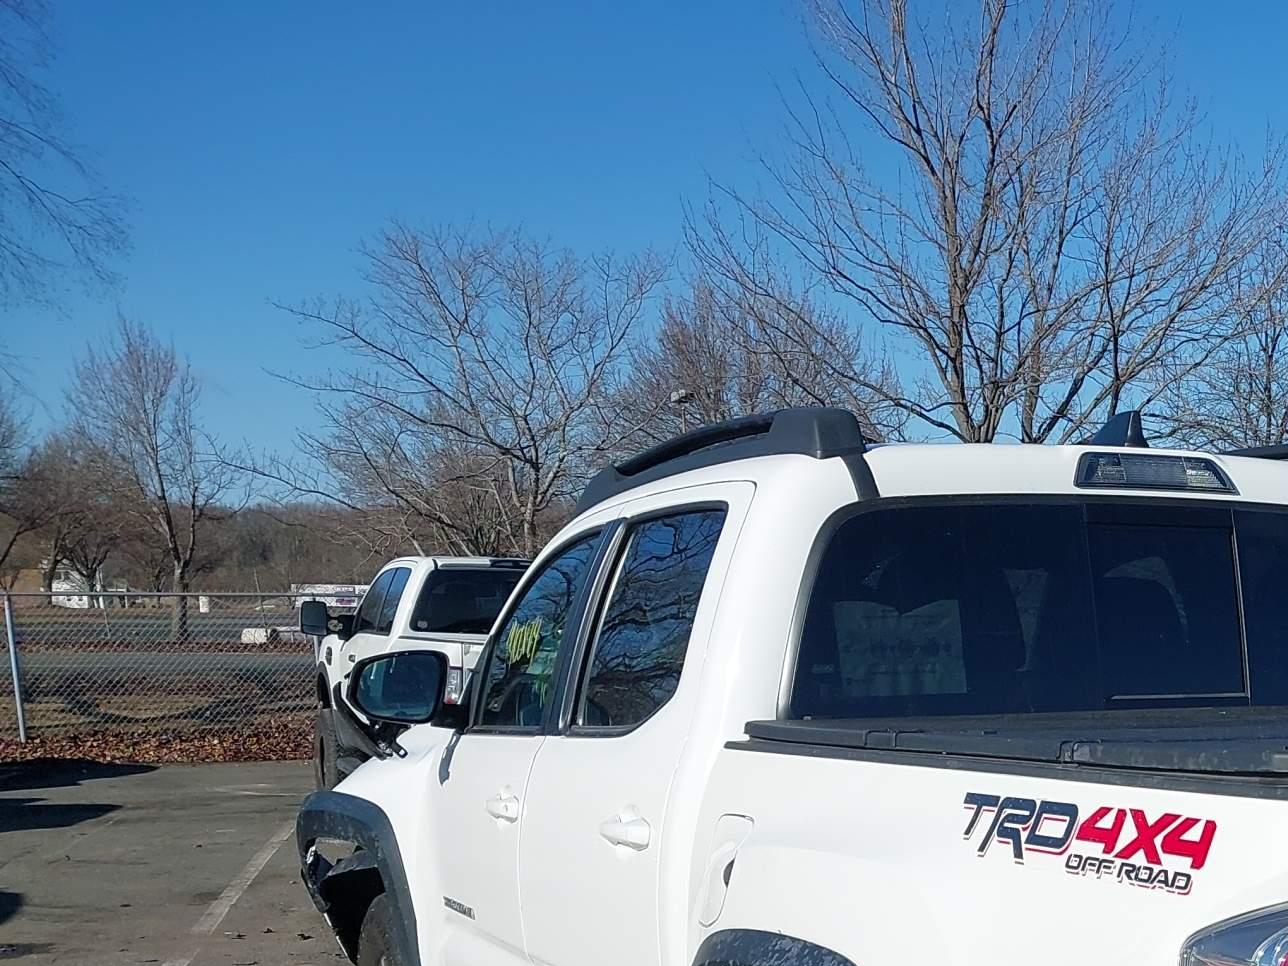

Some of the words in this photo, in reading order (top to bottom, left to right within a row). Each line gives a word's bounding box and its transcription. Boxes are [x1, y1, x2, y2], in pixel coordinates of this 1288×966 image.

[963, 792, 1080, 865] TRD
[1076, 806, 1217, 870] 4X4
[1065, 853, 1116, 879] OFF
[1116, 862, 1194, 896] ROAD
